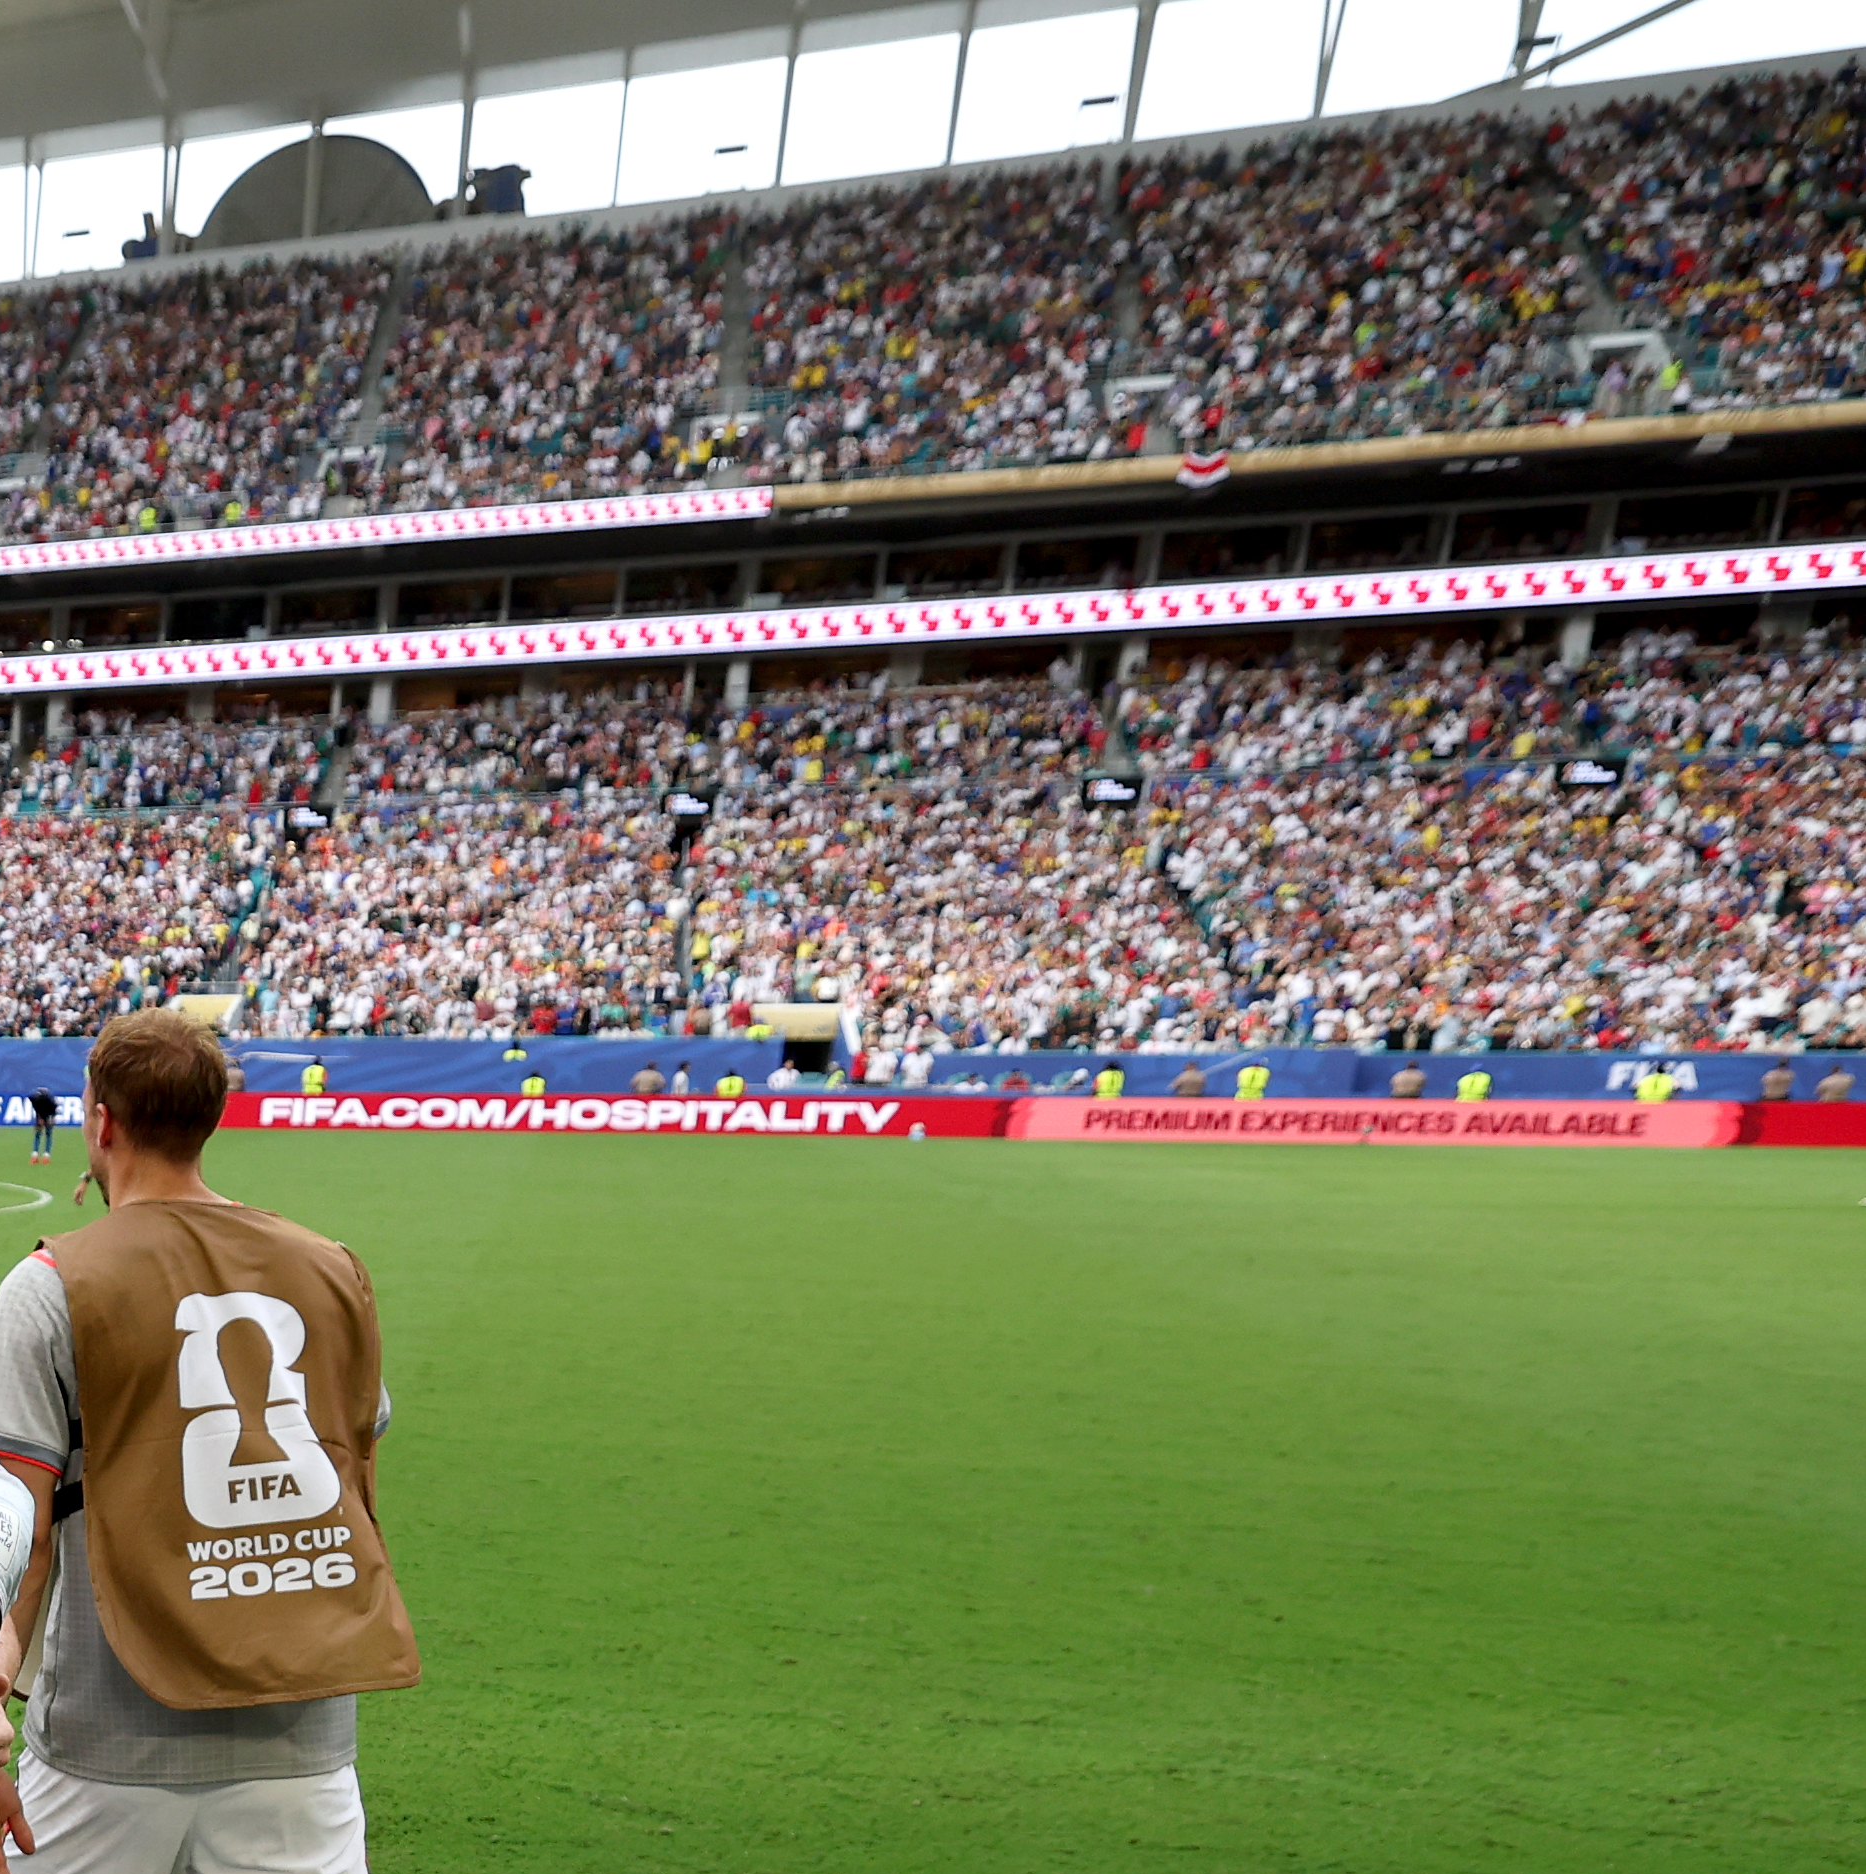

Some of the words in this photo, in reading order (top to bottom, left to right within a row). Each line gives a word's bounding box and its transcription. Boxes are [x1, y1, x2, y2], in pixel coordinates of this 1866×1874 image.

[260, 1096, 901, 1133] FIFA.COM/HOSPITALITY
[1084, 1108, 1231, 1132] PREMIUM
[1237, 1109, 1458, 1135] EXPERIENCES
[1464, 1111, 1650, 1137] AVAILABLE
[227, 1473, 302, 1503] FIFA
[186, 1533, 290, 1563] WORLD
[294, 1526, 351, 1551] CUP
[189, 1552, 356, 1600] 2026
